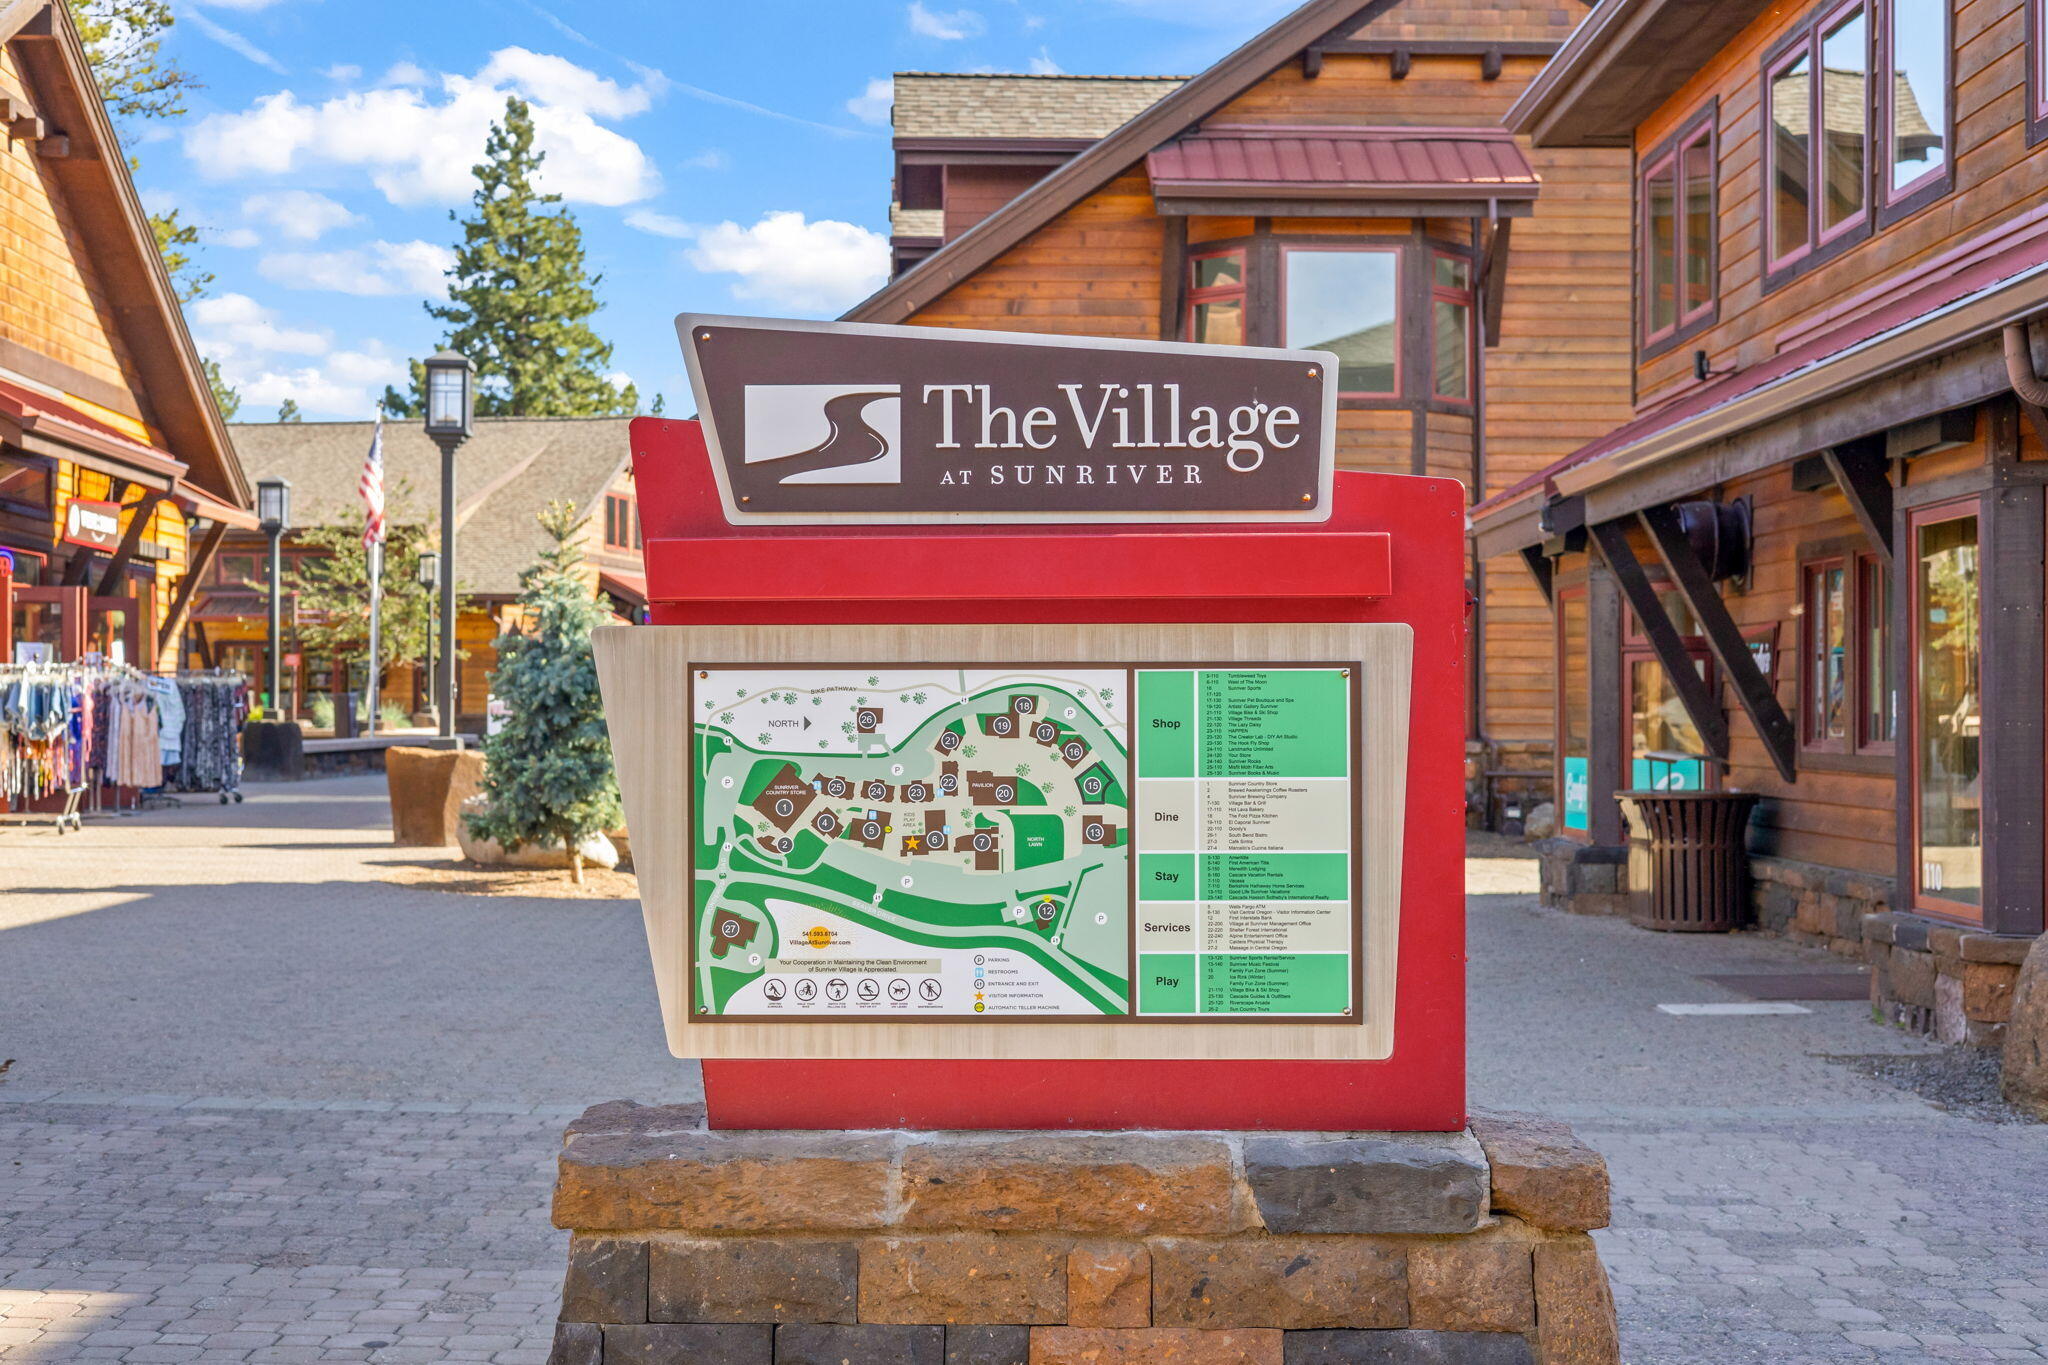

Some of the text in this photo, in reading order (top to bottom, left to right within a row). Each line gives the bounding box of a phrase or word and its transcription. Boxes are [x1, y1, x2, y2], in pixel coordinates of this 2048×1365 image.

[924, 383, 1301, 472] The Village
[940, 465, 1203, 485] AT SUNRIVER
[862, 716, 873, 724] 26
[1152, 719, 1181, 729] Shop
[1088, 782, 1098, 790] 15
[871, 788, 882, 796] 24
[1155, 812, 1179, 822] Dine
[1089, 829, 1100, 837] 13
[932, 836, 938, 844] 6
[1155, 872, 1179, 883] Stay
[1924, 863, 1942, 891] 110
[1041, 907, 1052, 915] 12
[724, 925, 736, 933] 27
[1144, 923, 1191, 932] Services
[1156, 977, 1179, 988] Play
